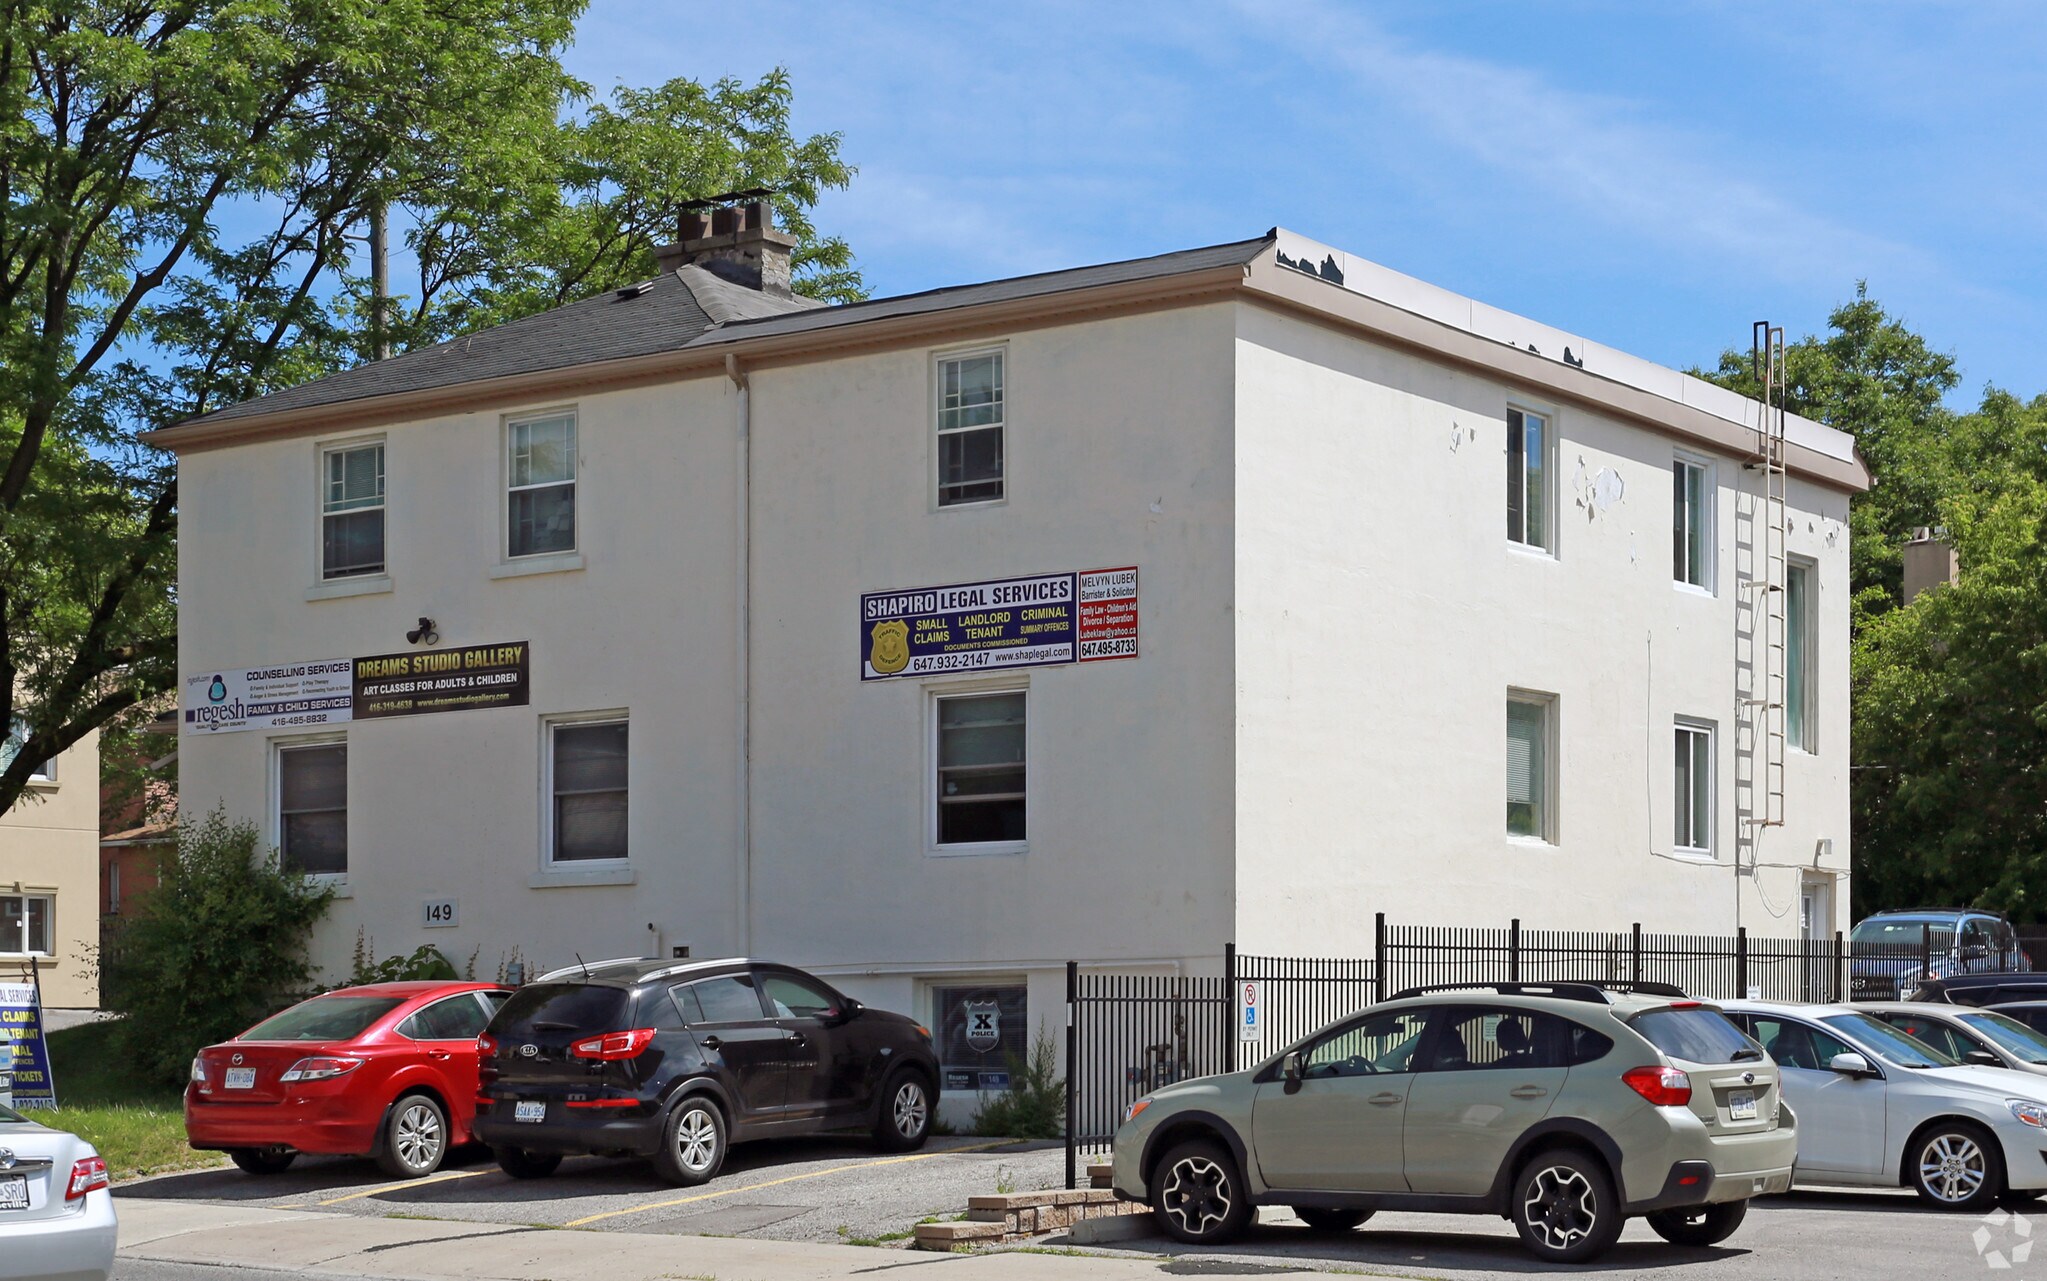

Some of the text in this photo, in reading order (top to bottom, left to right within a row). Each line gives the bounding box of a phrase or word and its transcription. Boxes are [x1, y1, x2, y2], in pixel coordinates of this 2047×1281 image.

[1082, 573, 1135, 588] MELVYN LUBEK
[867, 580, 1069, 617] SHAPIRO LEGAL SERVICES
[1082, 589, 1105, 600] Barrister
[1112, 586, 1135, 597] Solicitor
[1021, 606, 1068, 621] CRIMINAL
[1080, 606, 1094, 617] Family
[916, 618, 948, 631] SMALL
[958, 611, 1011, 627] LANDLORD
[1083, 616, 1102, 626] Divorce
[1106, 613, 1134, 625] Separation
[878, 628, 901, 639] TRAFFIC
[965, 626, 1004, 639] TENANT
[1020, 621, 1069, 635] SUMMARY OFFENCES
[914, 631, 950, 644] CLAIMS
[944, 637, 1028, 651] DOCUMENTS COMMISSIONED
[1082, 639, 1136, 656] 647.495-8733
[357, 646, 523, 679] DREAMS STUDIO GALLERY
[878, 653, 902, 665] DEFENCE
[913, 647, 1070, 671] 647.932-2147 www.shaplegal.com
[247, 662, 350, 681] COUNSELLING SERVICES
[363, 672, 518, 696] ART CLASSES FOR ADULTS & CHILDREN
[248, 698, 350, 715] FAMILY & CHILD SERVICES
[196, 697, 246, 731] regesh
[271, 713, 327, 726] 416-495-8832
[426, 904, 452, 921] 149
[2, 1010, 36, 1023] CLAIMS
[975, 1014, 992, 1029] X
[11, 1028, 38, 1039] TENANT
[13, 1071, 43, 1082] TICKETS
